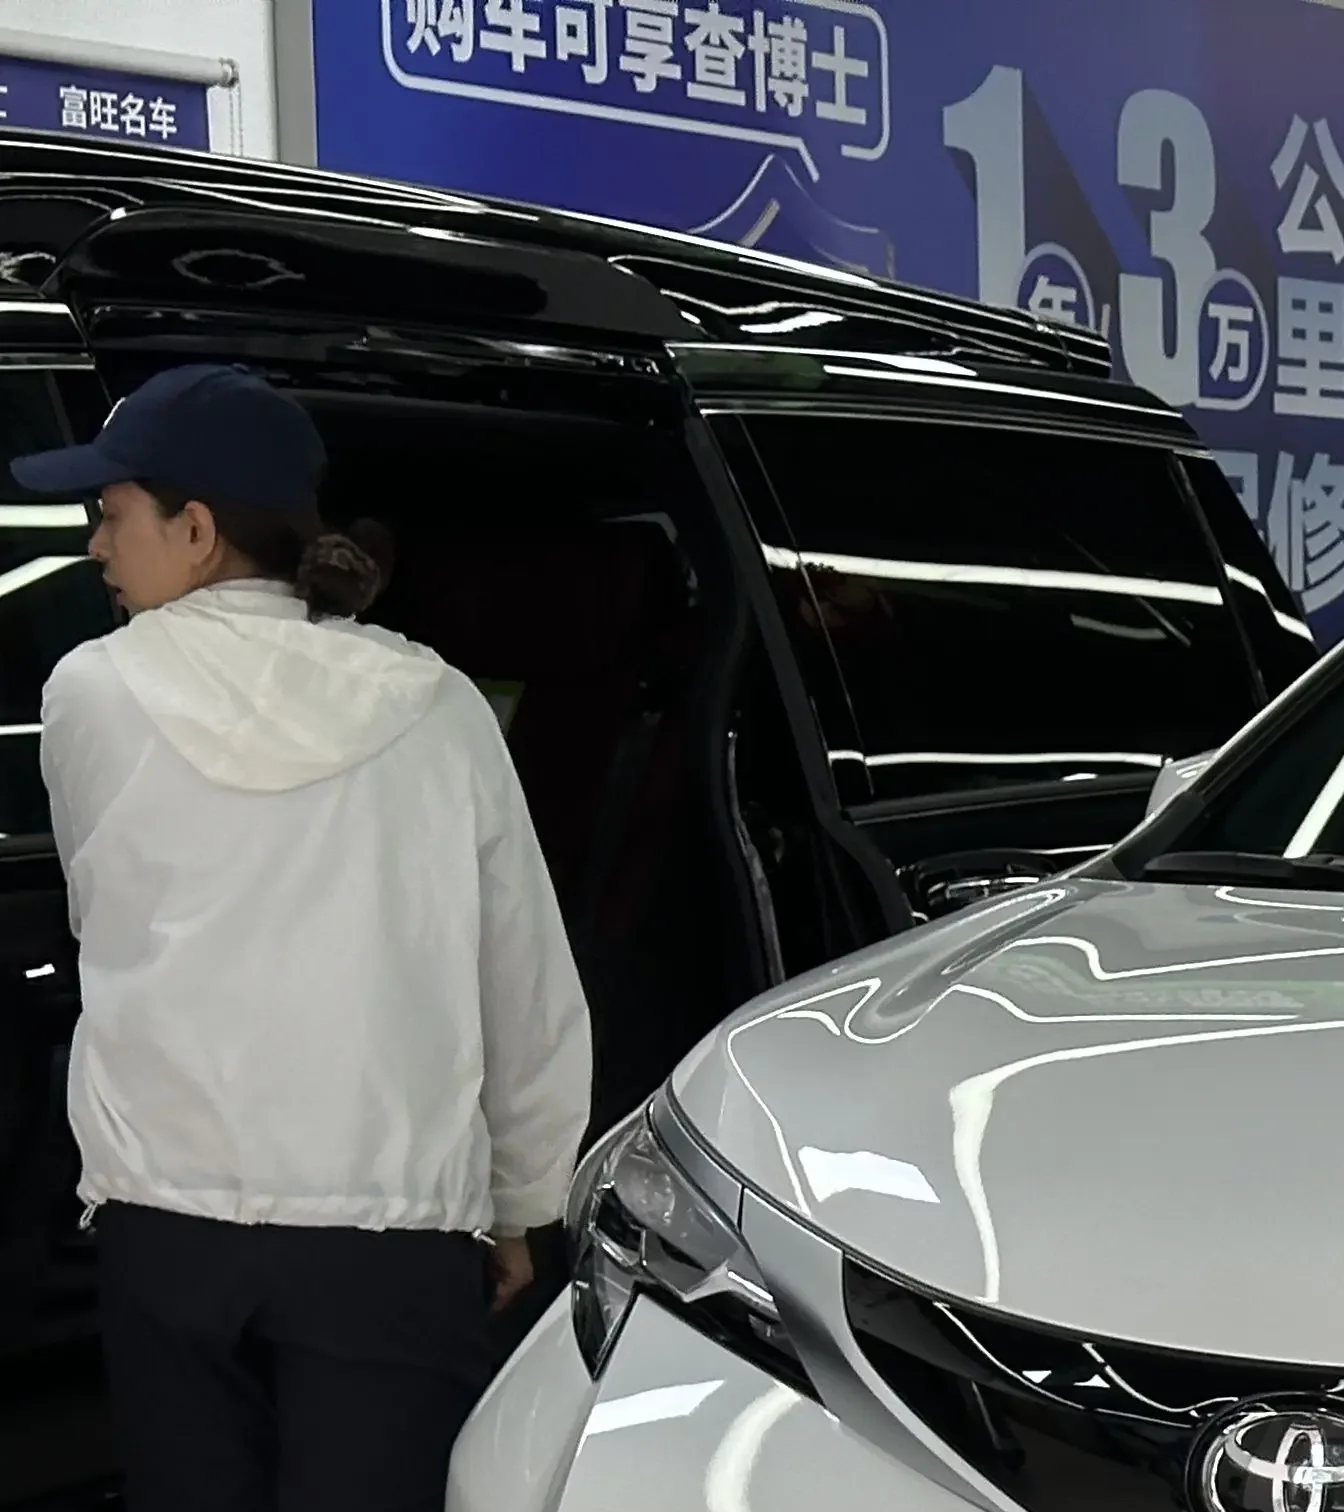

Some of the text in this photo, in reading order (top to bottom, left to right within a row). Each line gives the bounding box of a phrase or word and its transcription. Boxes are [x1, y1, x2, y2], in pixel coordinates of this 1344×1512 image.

[406, 0, 869, 125] 购车可享查博士
[59, 84, 178, 140] 富旺名车
